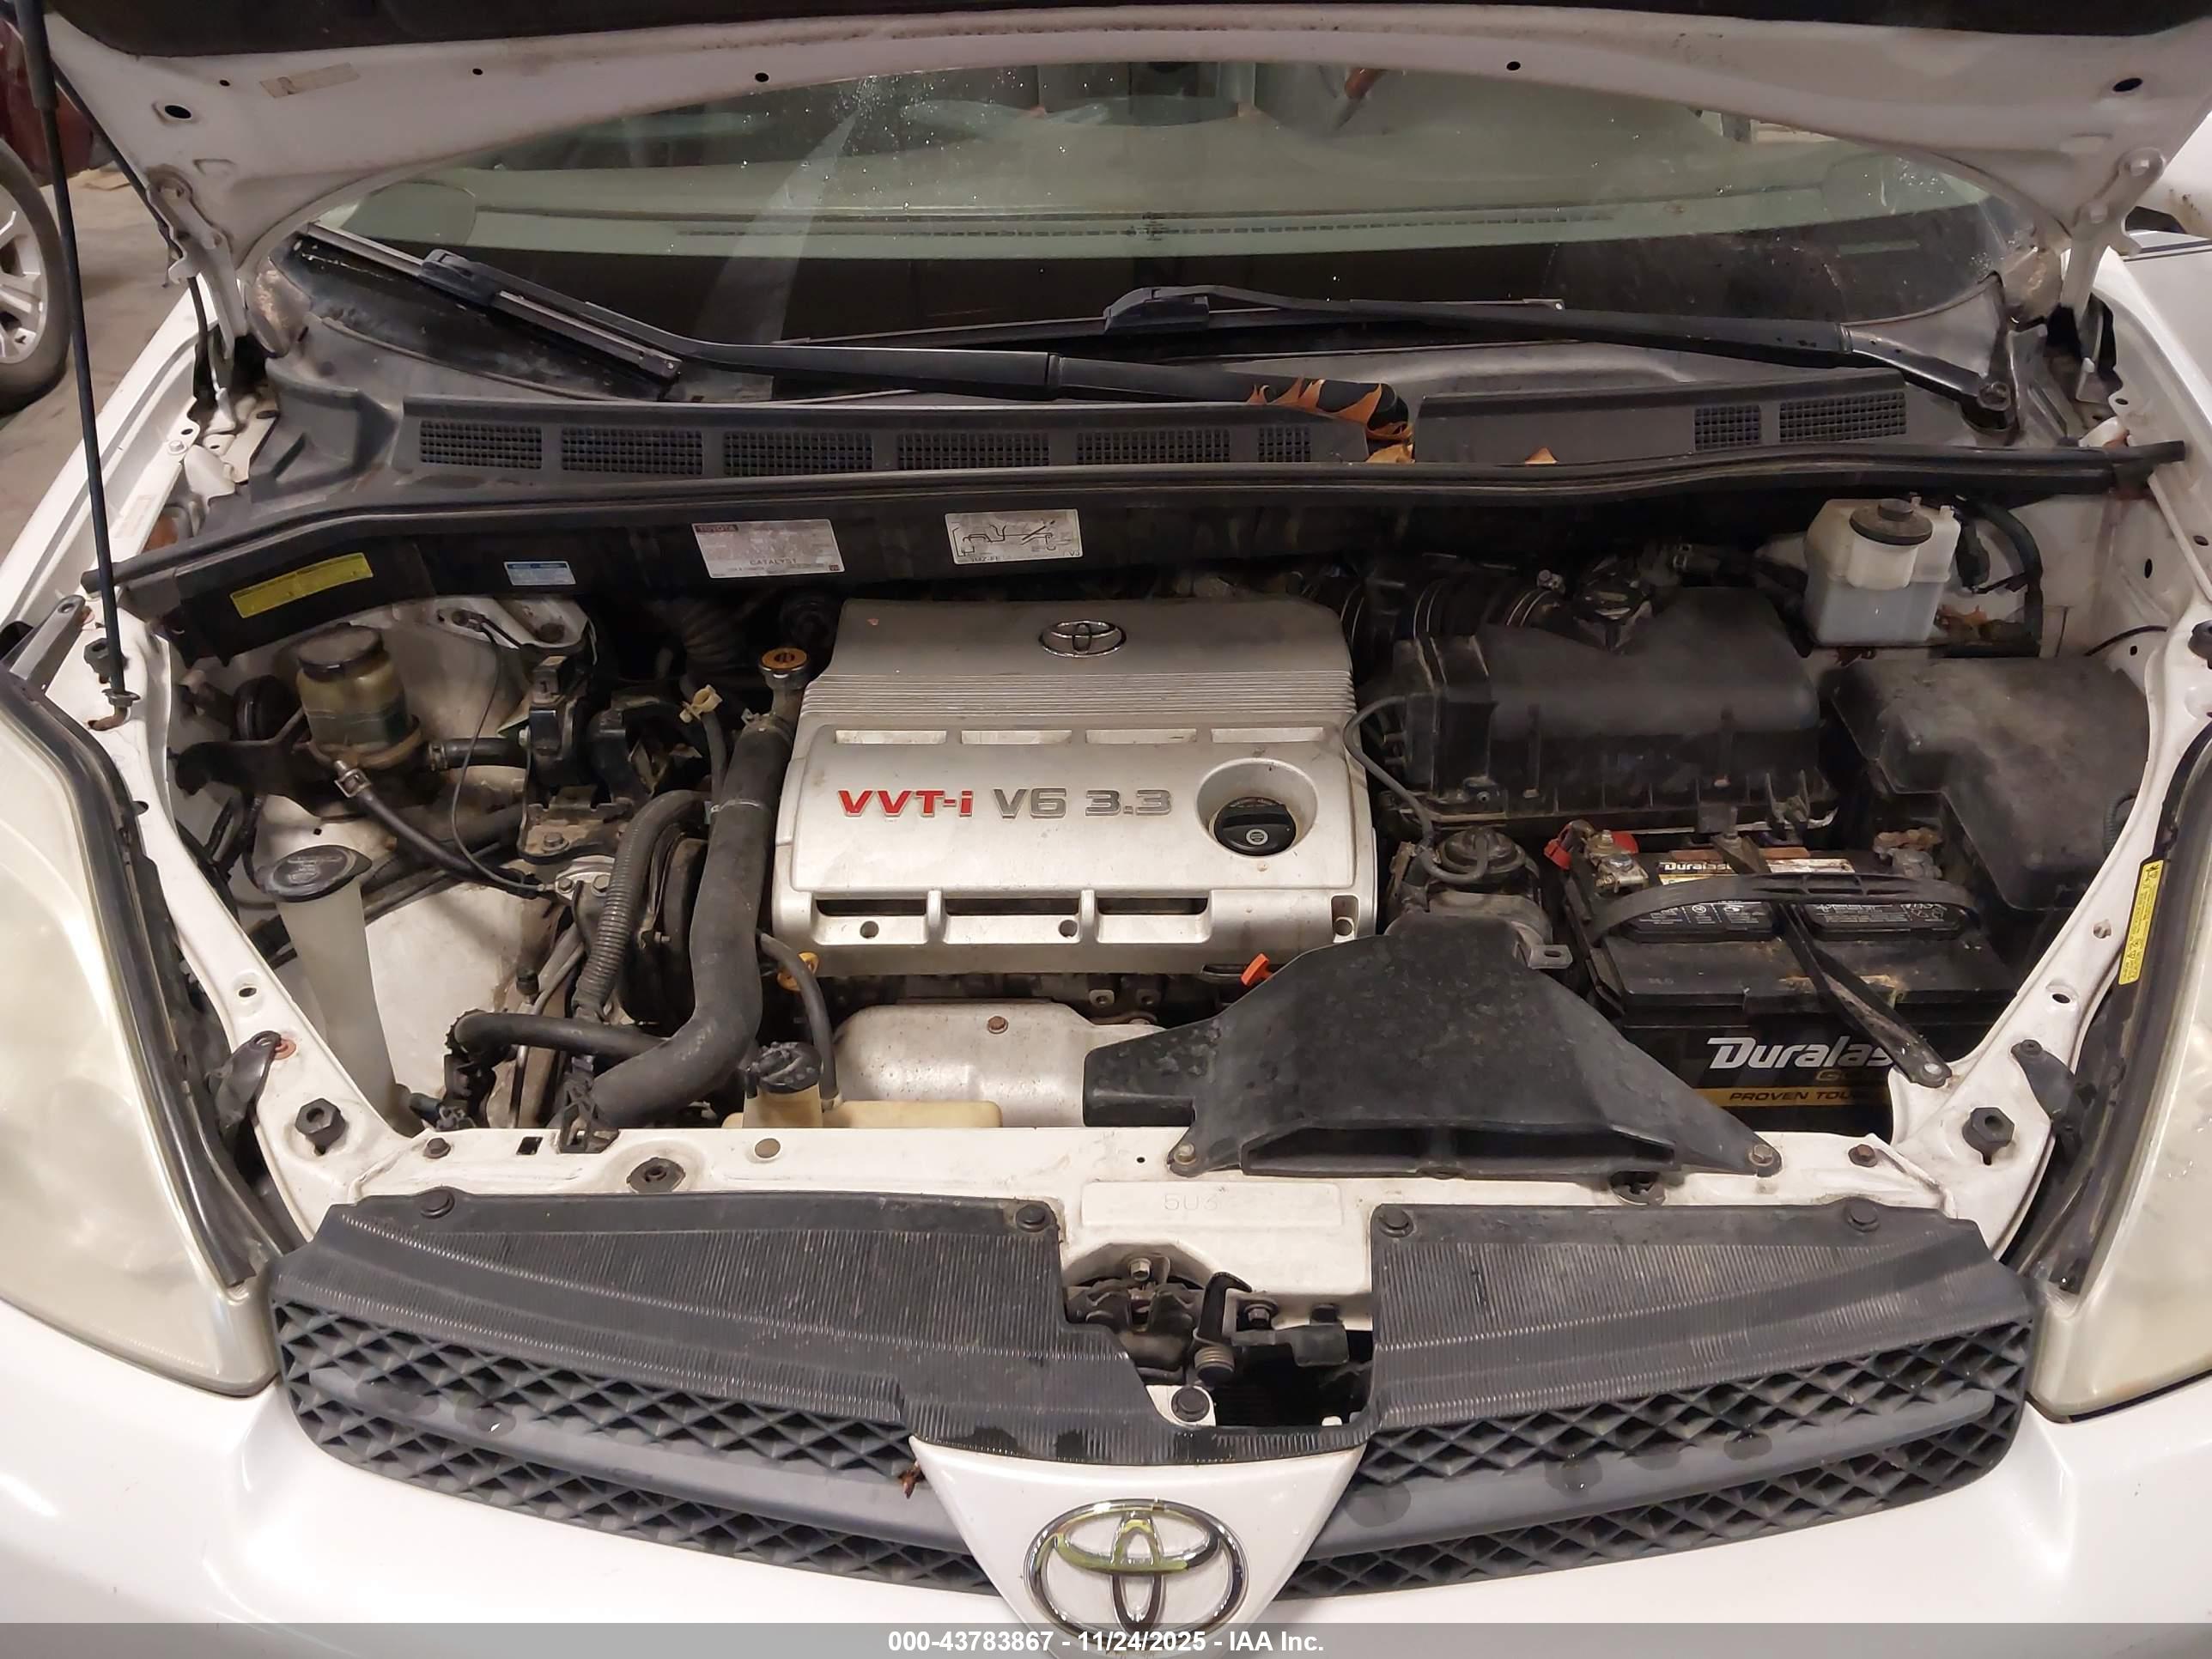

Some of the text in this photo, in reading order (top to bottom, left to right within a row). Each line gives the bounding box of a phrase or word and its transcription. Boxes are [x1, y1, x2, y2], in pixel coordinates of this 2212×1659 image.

[838, 787, 1173, 818] VVT-i V6 3.3
[1707, 1036, 1894, 1069] Duralas
[1729, 1091, 1808, 1102] PROVEN
